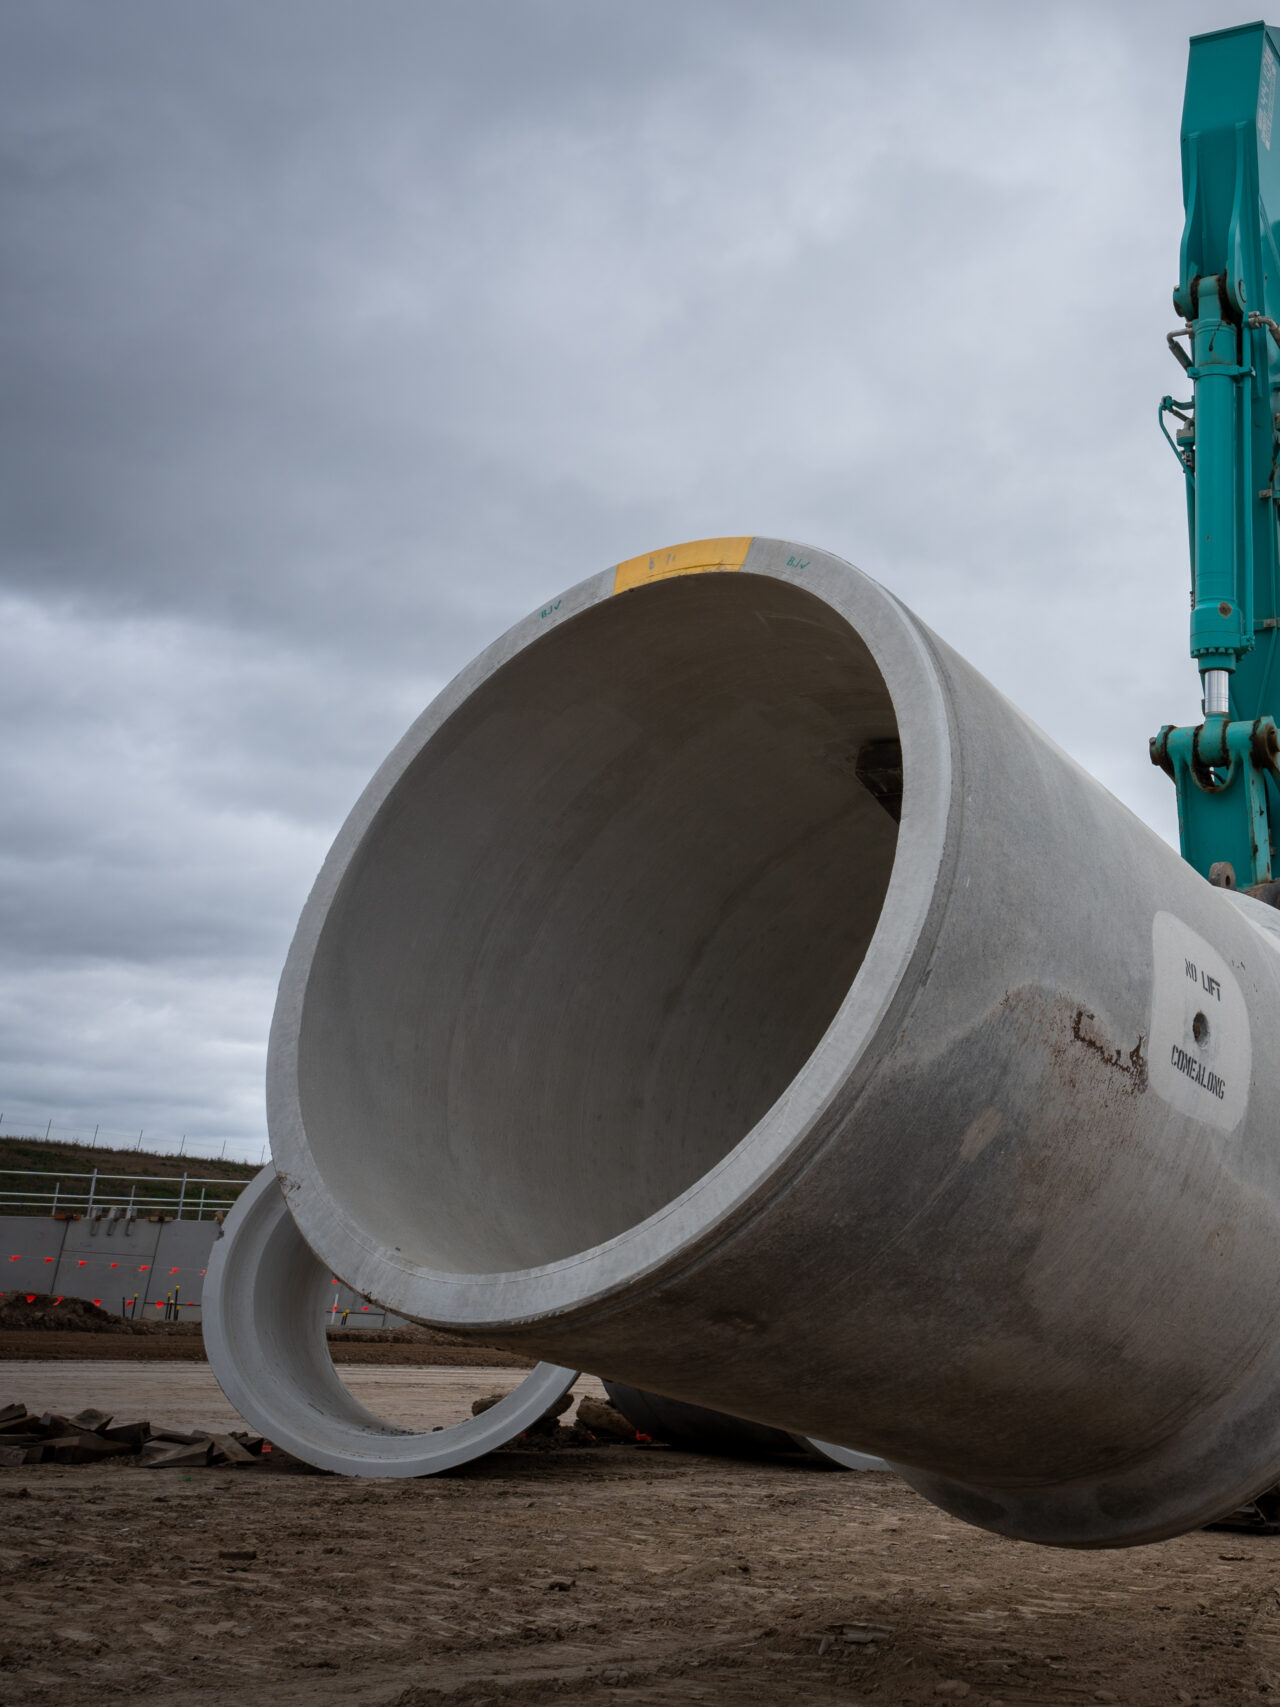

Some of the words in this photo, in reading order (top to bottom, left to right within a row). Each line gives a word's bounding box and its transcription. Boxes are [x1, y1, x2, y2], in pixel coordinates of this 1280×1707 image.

[1184, 957, 1198, 983] NO
[1201, 970, 1222, 1002] LIFT
[1170, 1044, 1226, 1101] COMEALONG
